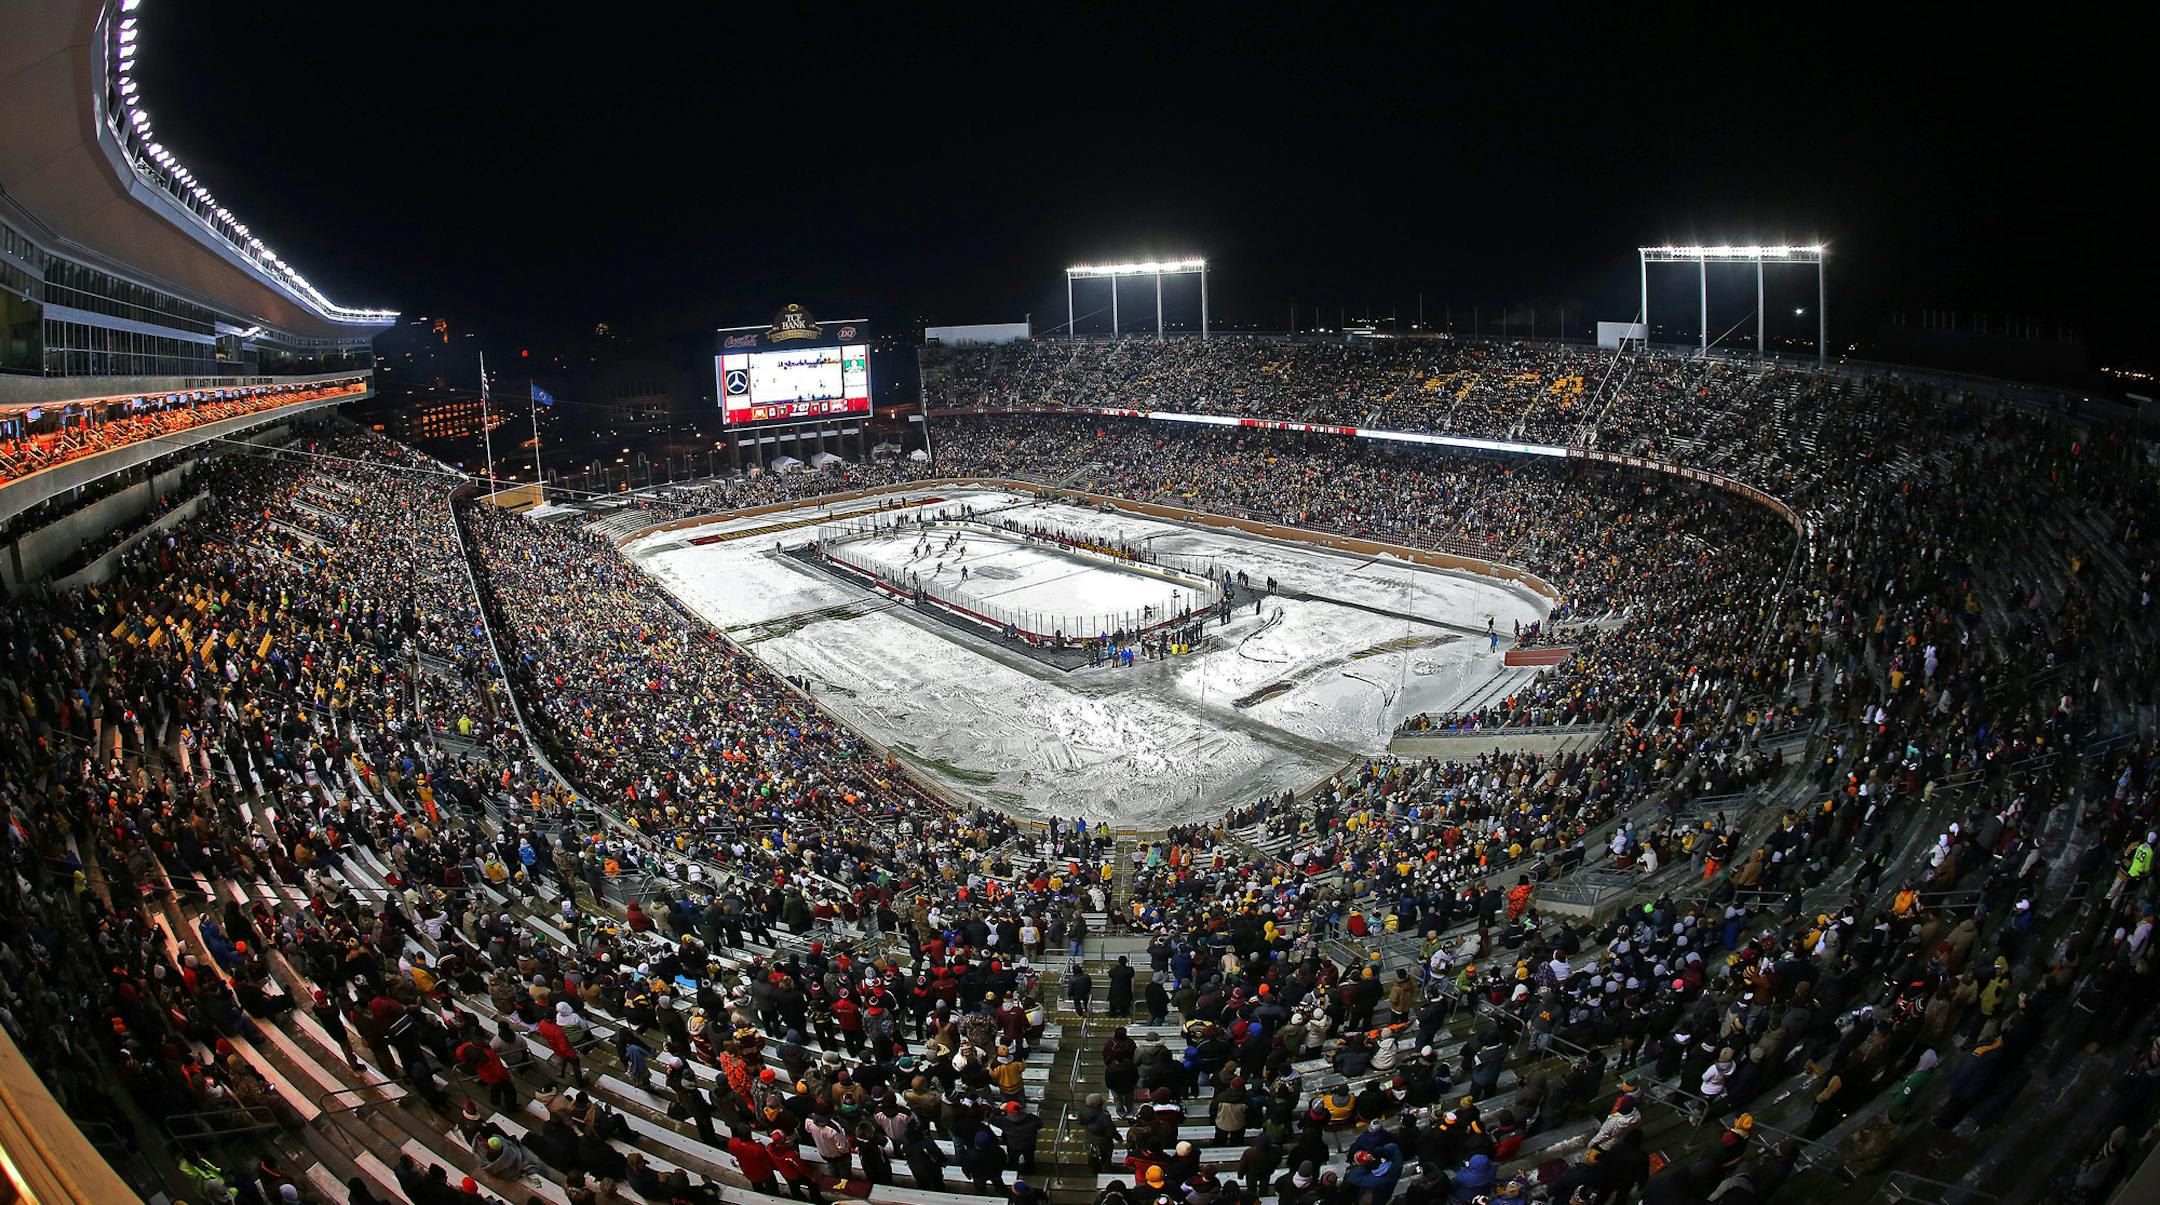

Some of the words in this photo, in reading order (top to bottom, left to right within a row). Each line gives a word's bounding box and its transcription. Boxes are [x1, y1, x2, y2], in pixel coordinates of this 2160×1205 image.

[785, 313, 803, 323] TCF
[782, 320, 806, 329] BANK
[1569, 449, 1584, 458] 1900
[1589, 452, 1604, 460] 1903
[1608, 455, 1622, 463] 1904
[1627, 458, 1641, 466] 1906
[1646, 461, 1660, 470] 1909
[1663, 464, 1677, 474] 1910
